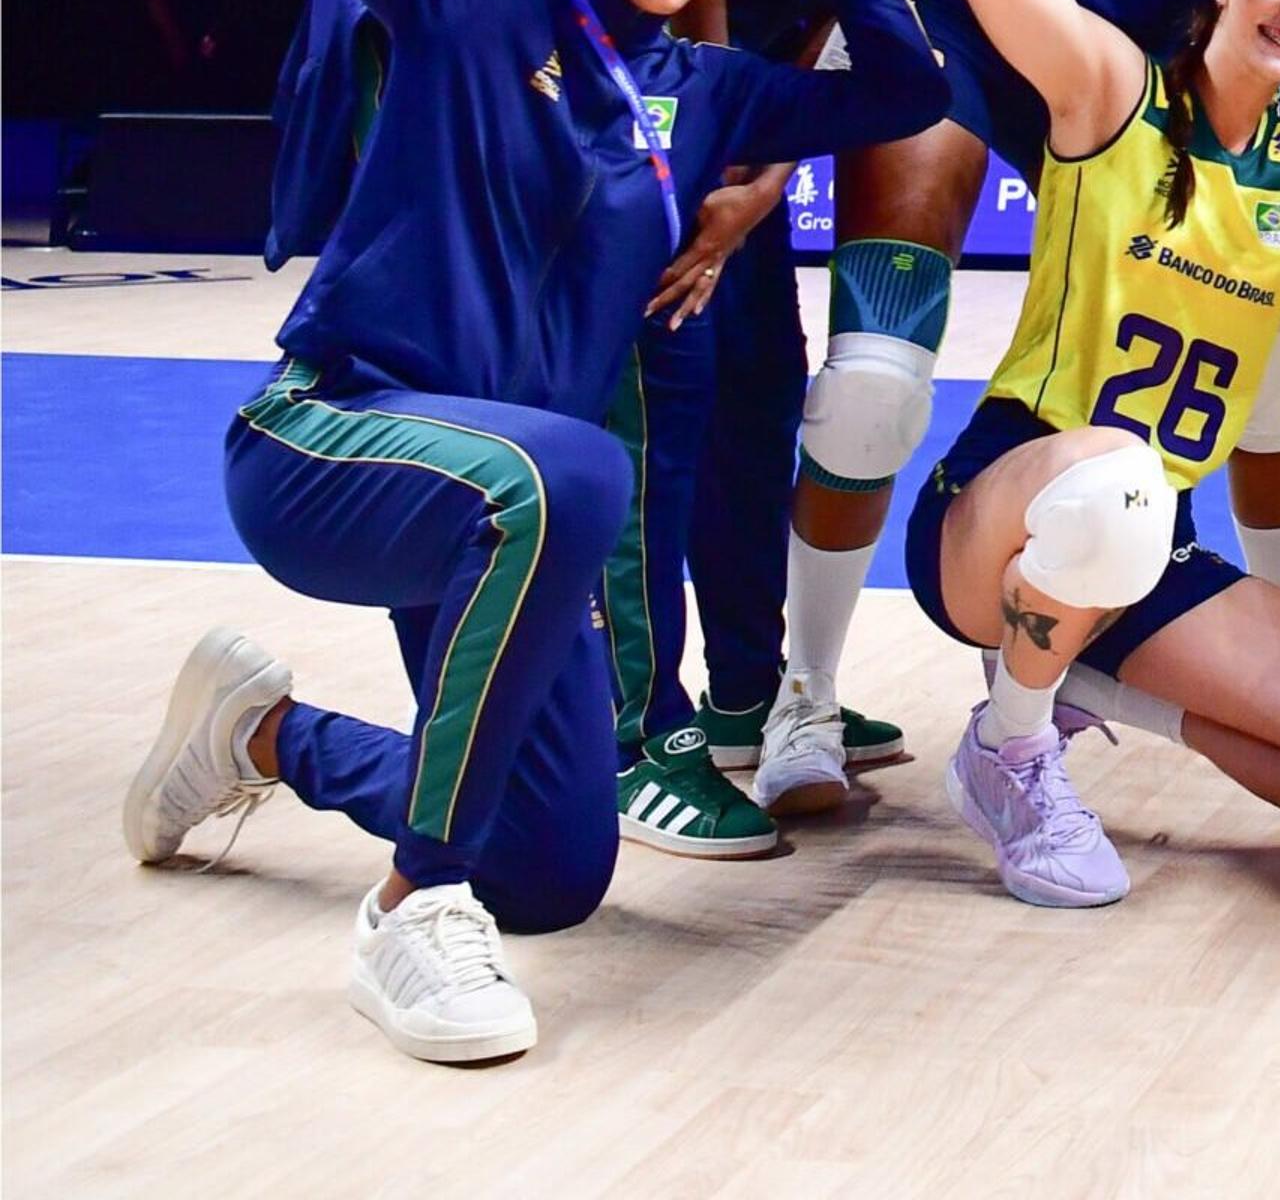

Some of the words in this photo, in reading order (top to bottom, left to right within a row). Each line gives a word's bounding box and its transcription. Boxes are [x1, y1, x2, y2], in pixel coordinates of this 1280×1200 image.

[1159, 247, 1214, 286] BANCO
[1214, 275, 1238, 294] DO
[1089, 312, 1240, 463] 26
